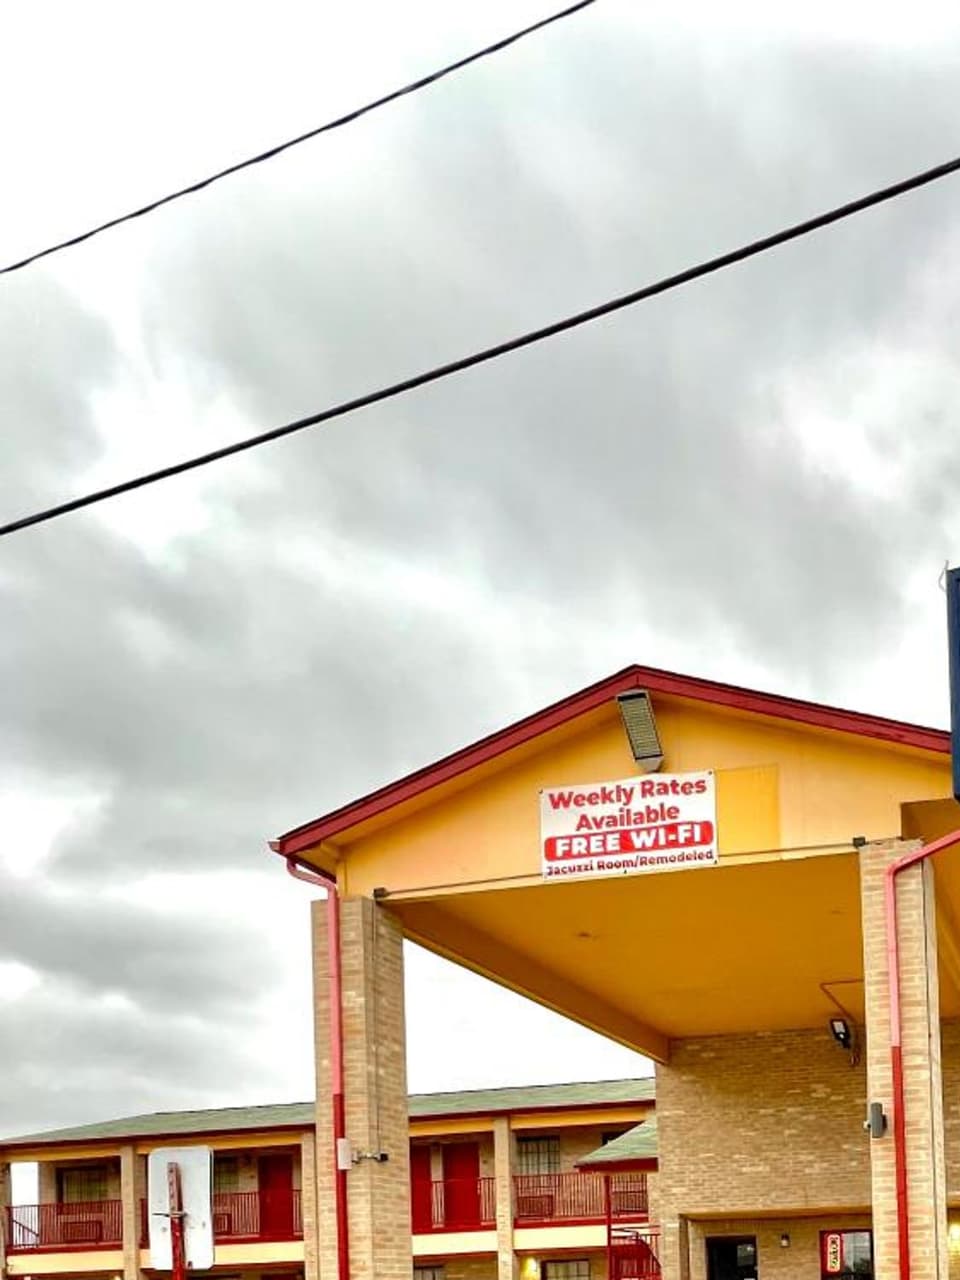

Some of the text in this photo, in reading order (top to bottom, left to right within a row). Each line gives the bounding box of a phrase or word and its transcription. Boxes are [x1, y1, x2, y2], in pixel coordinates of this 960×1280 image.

[548, 778, 707, 810] Weekly Rates
[576, 803, 680, 831] Available
[555, 823, 701, 857] FREE WI-FI
[546, 850, 714, 877] Jacuzzi Room/Remodeled
